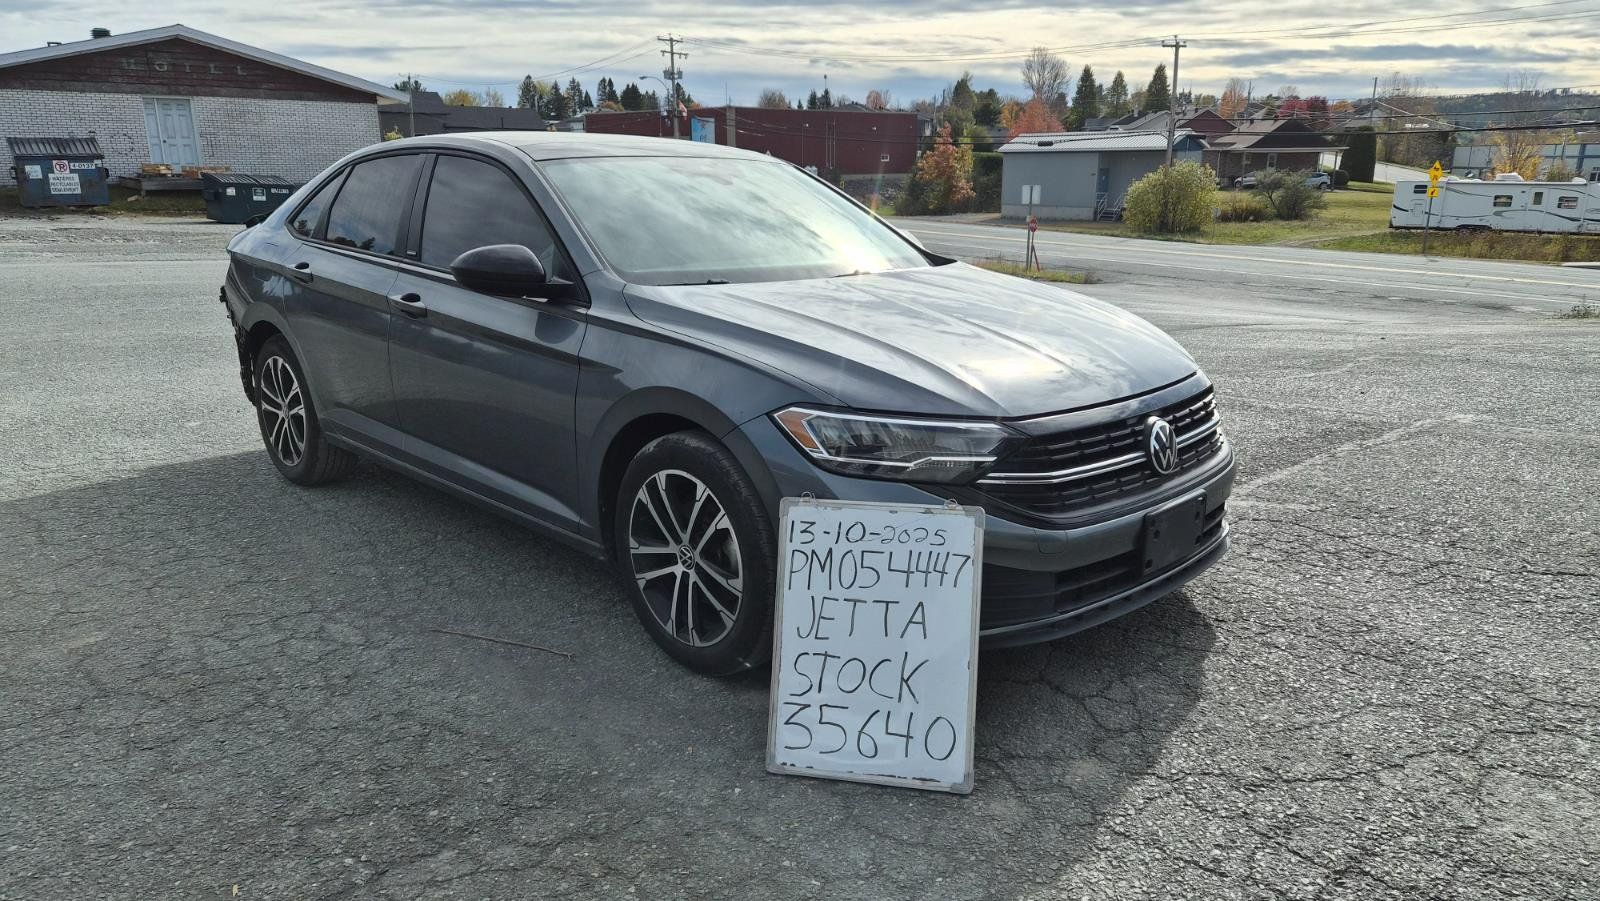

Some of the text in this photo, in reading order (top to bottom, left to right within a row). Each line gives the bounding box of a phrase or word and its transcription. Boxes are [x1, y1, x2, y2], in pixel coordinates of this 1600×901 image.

[789, 521, 946, 545] 13-10-2025
[789, 548, 971, 590] PM054447
[797, 596, 928, 640] JETTA
[789, 651, 929, 704] STOCK
[783, 702, 957, 761] 35640
